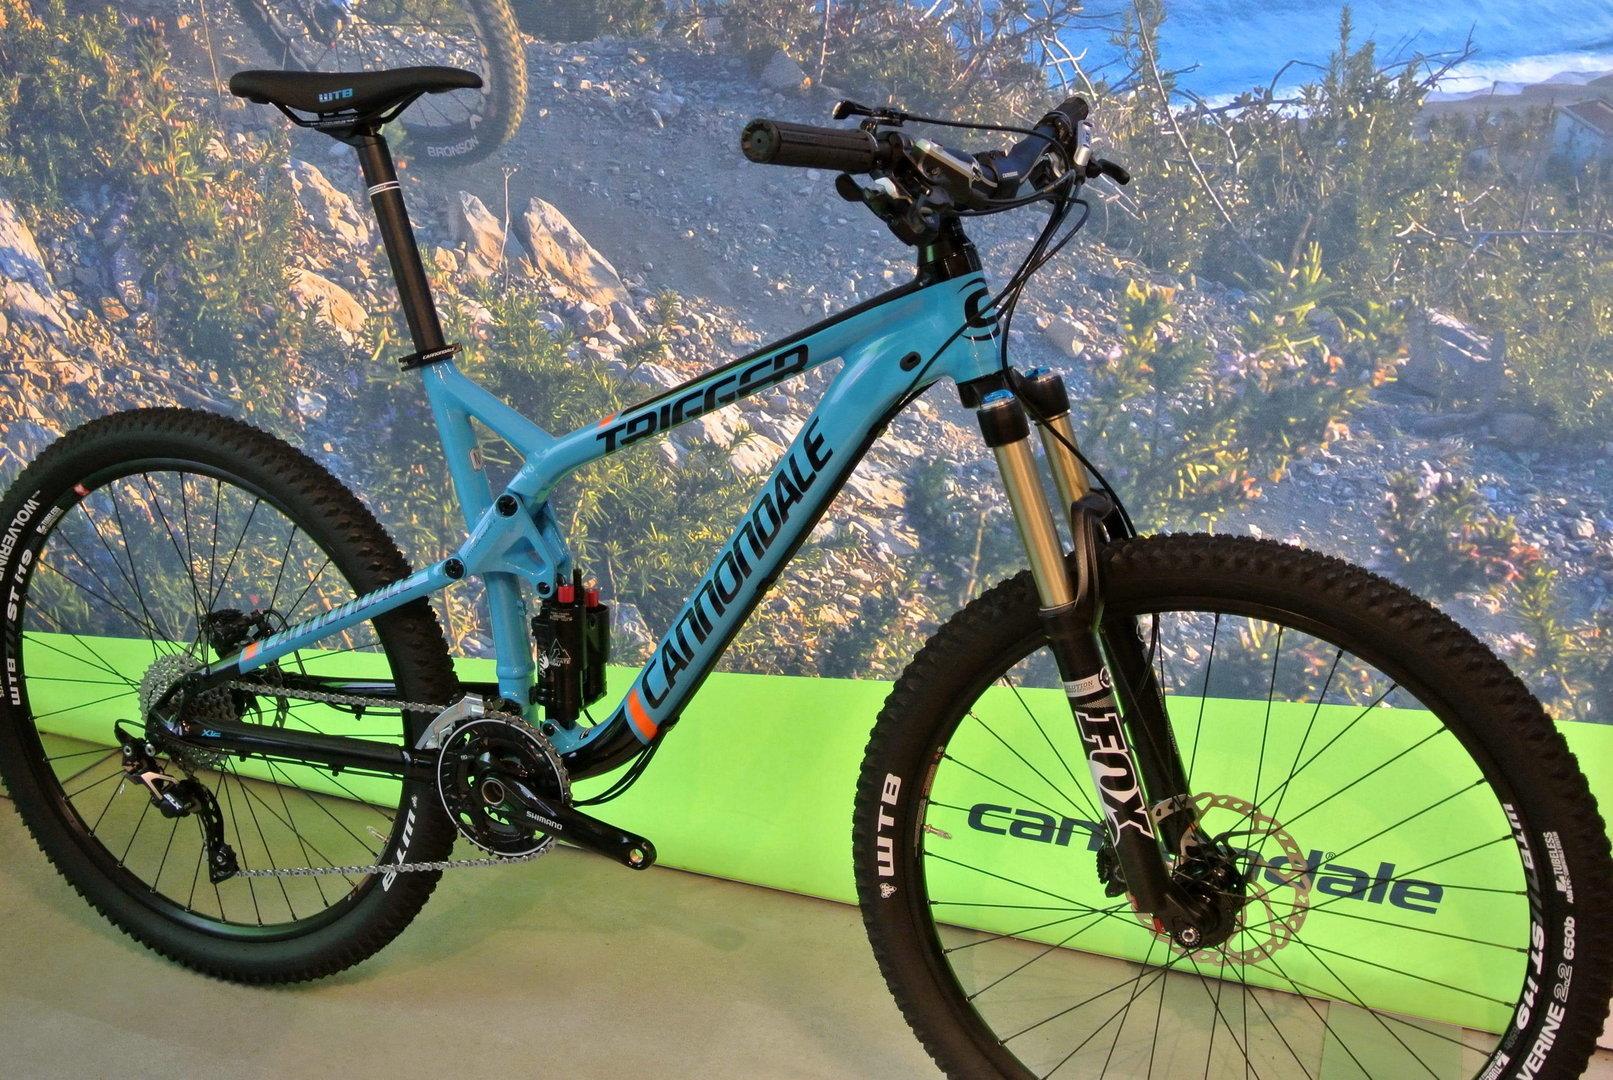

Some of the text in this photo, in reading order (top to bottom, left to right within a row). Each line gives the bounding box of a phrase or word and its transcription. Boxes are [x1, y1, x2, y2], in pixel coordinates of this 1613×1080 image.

[318, 88, 353, 103] WTB
[427, 135, 480, 158] BRONSON
[596, 344, 809, 453] TRIGGER
[641, 416, 834, 710] CANNONDALE
[7, 658, 20, 705] WTB
[1074, 711, 1155, 847] FOX
[526, 810, 563, 831] SHIMANO
[877, 773, 902, 877] WTB
[1503, 803, 1534, 870] WTB
[1553, 963, 1573, 1003] 2.2
[1563, 916, 1576, 960] 650b
